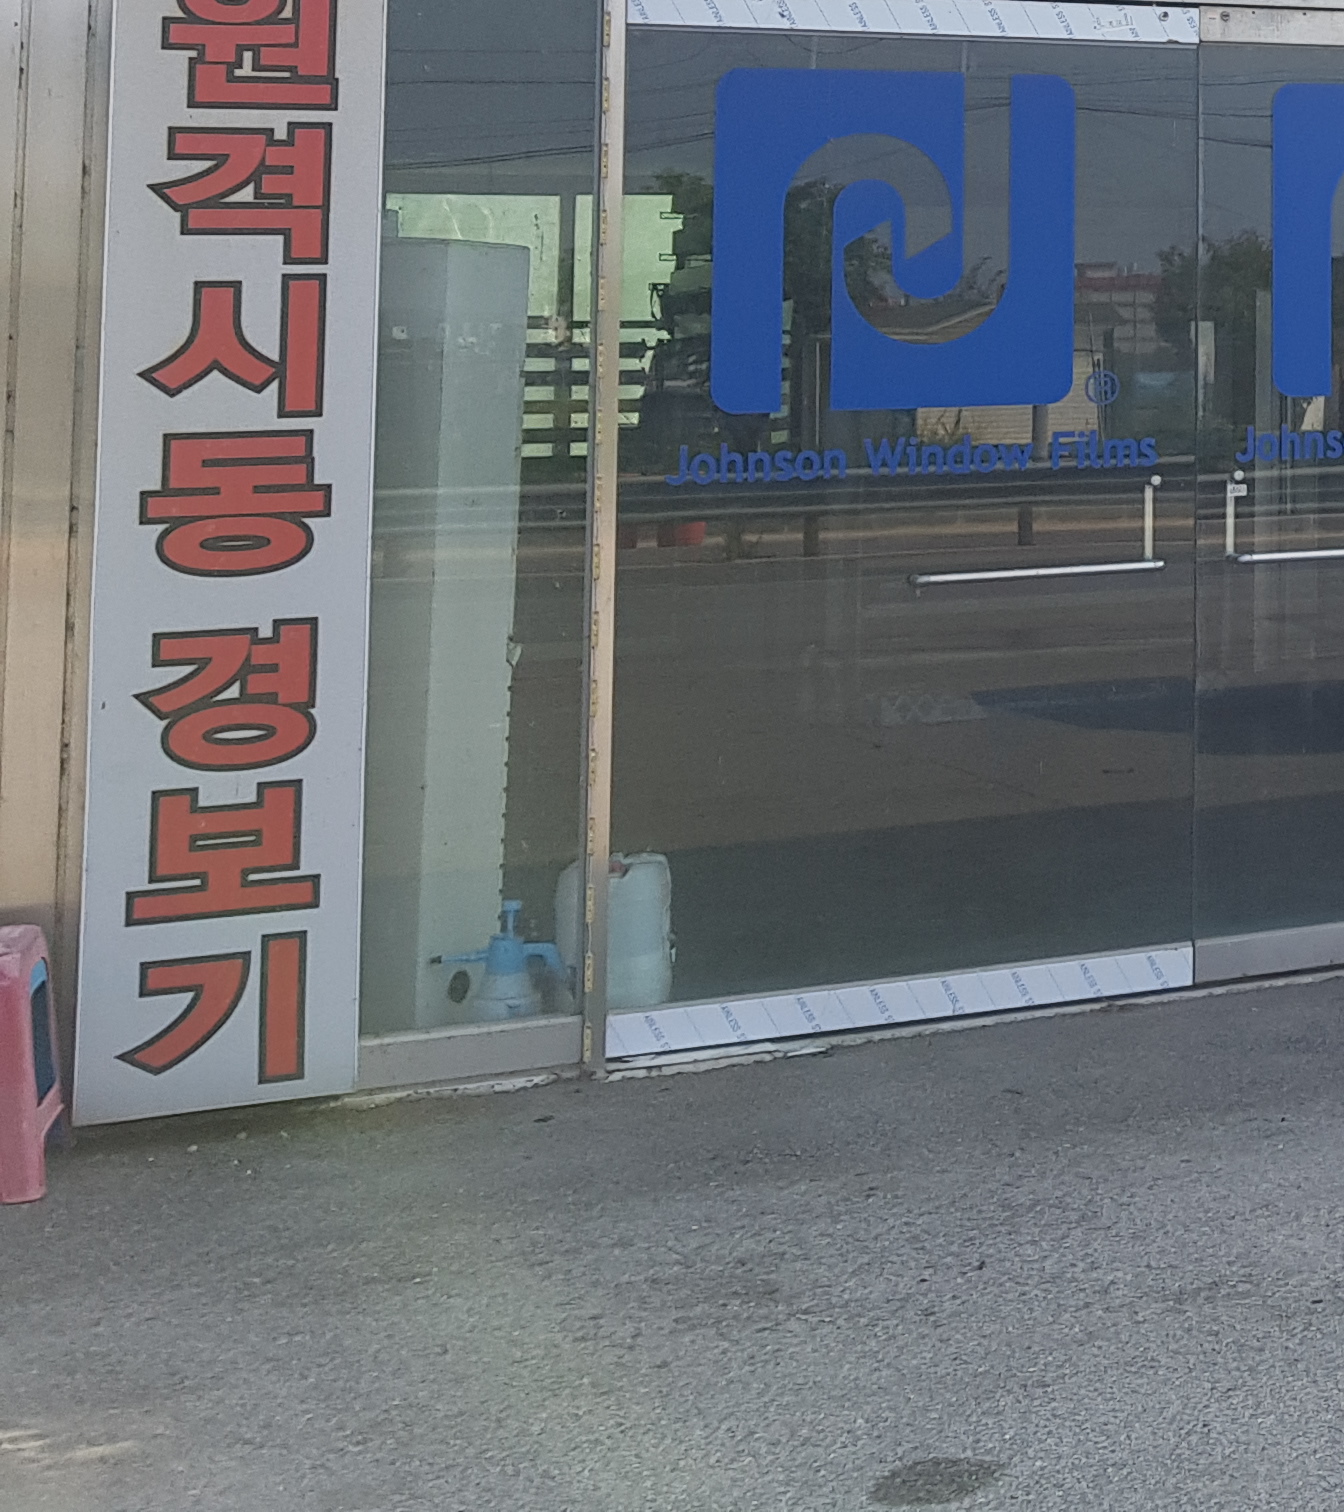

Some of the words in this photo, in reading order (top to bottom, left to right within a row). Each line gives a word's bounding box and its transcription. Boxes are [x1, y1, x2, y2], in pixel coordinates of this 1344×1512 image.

[664, 442, 847, 487] Johnson
[863, 433, 1034, 477] Window
[1050, 429, 1160, 470] Films
